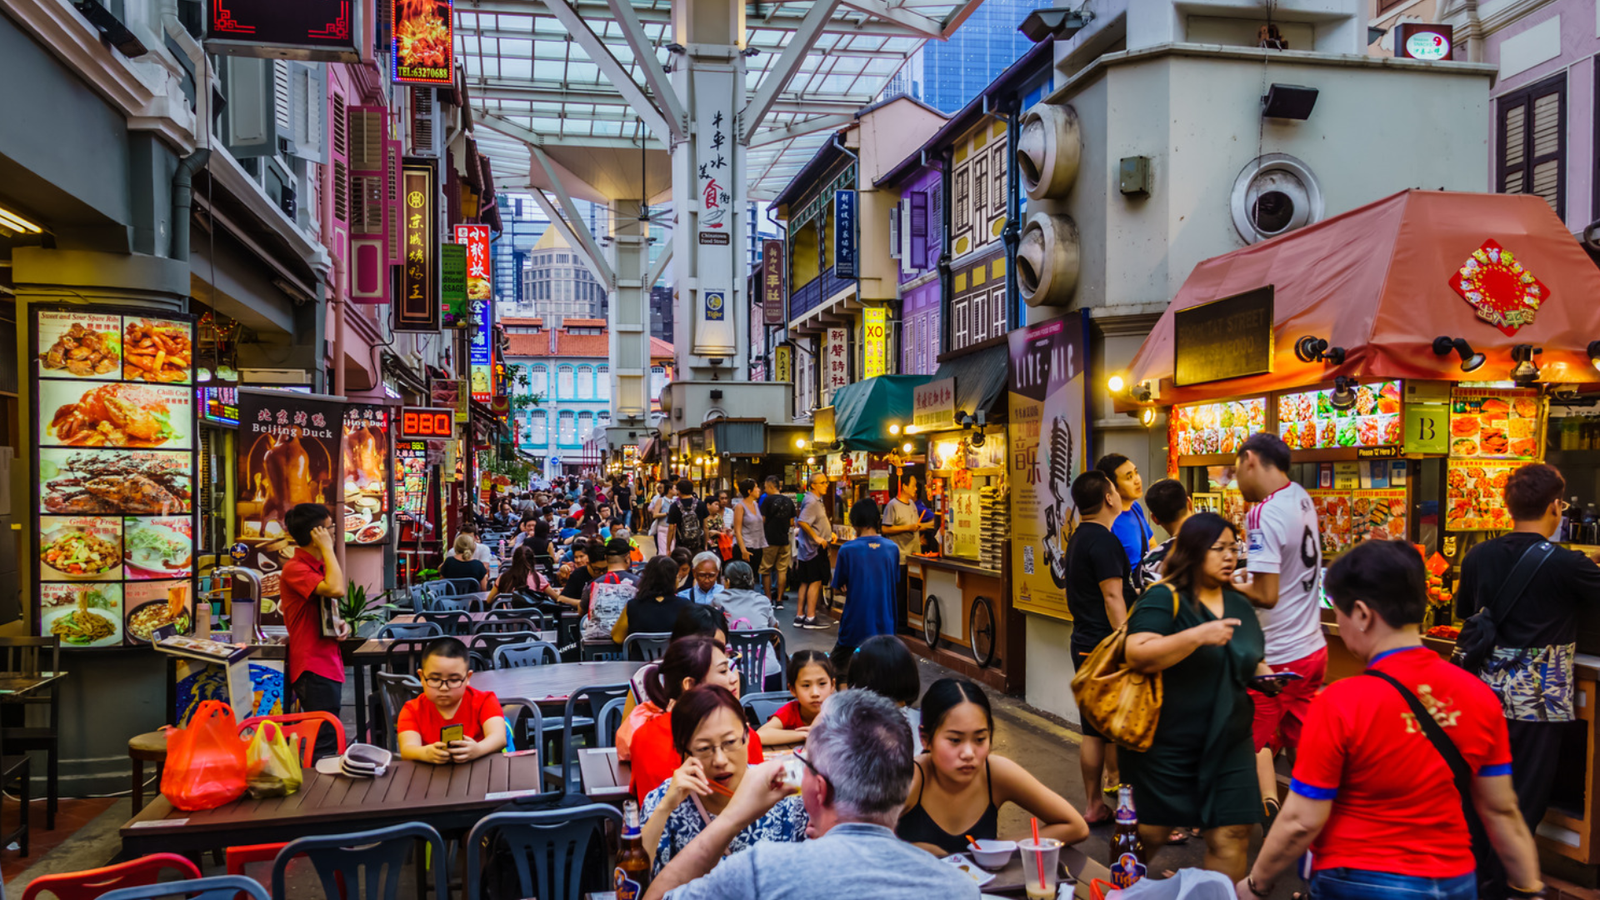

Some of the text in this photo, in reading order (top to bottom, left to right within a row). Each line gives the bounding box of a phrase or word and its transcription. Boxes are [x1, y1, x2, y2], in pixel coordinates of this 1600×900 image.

[397, 66, 448, 79] TEL:63270688
[707, 311, 722, 319] Tiger
[1015, 344, 1074, 389] LIVE MIC
[252, 423, 332, 439] Beijing Duck
[404, 413, 451, 435] BBQ
[1419, 417, 1436, 441] B
[231, 551, 247, 559] Tiger
